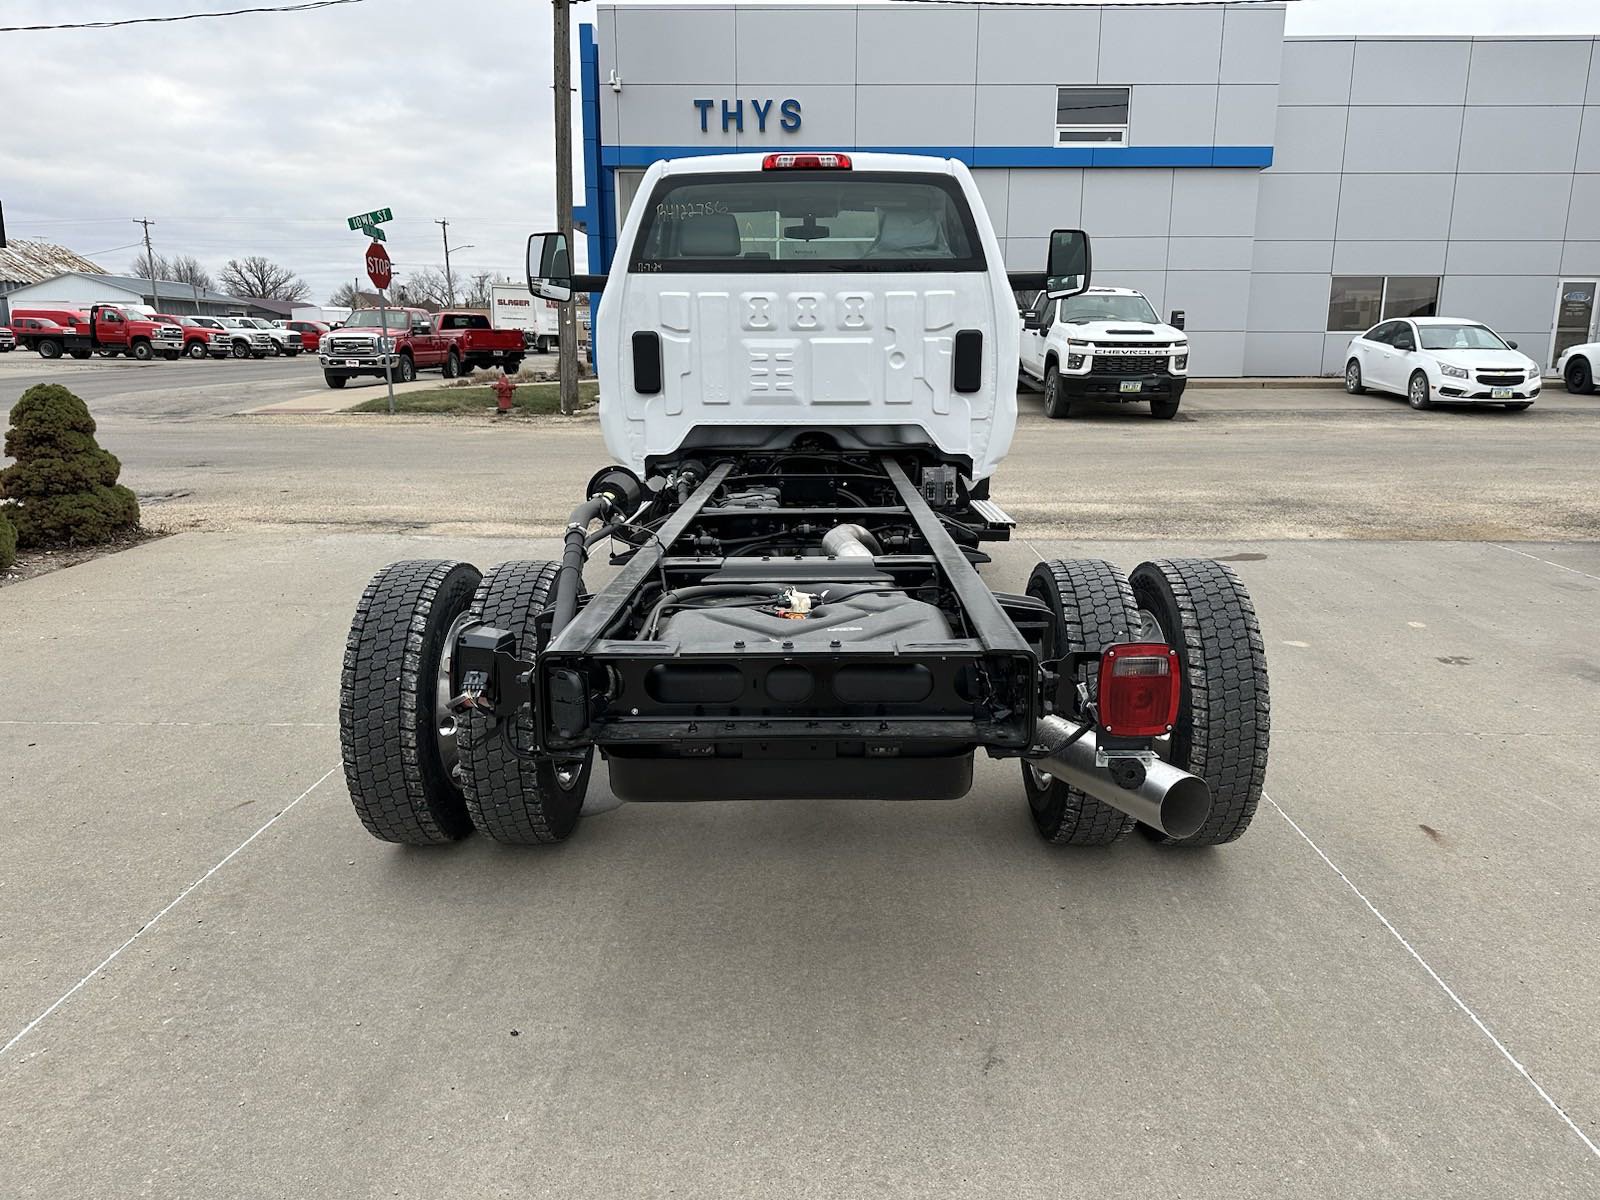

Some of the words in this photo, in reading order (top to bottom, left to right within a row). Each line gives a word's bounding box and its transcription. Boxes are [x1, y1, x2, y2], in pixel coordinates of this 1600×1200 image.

[693, 99, 802, 133] THYS
[352, 213, 374, 228] IOWA
[377, 210, 388, 221] ST
[367, 256, 390, 275] STOP
[497, 299, 530, 307] SLAGER
